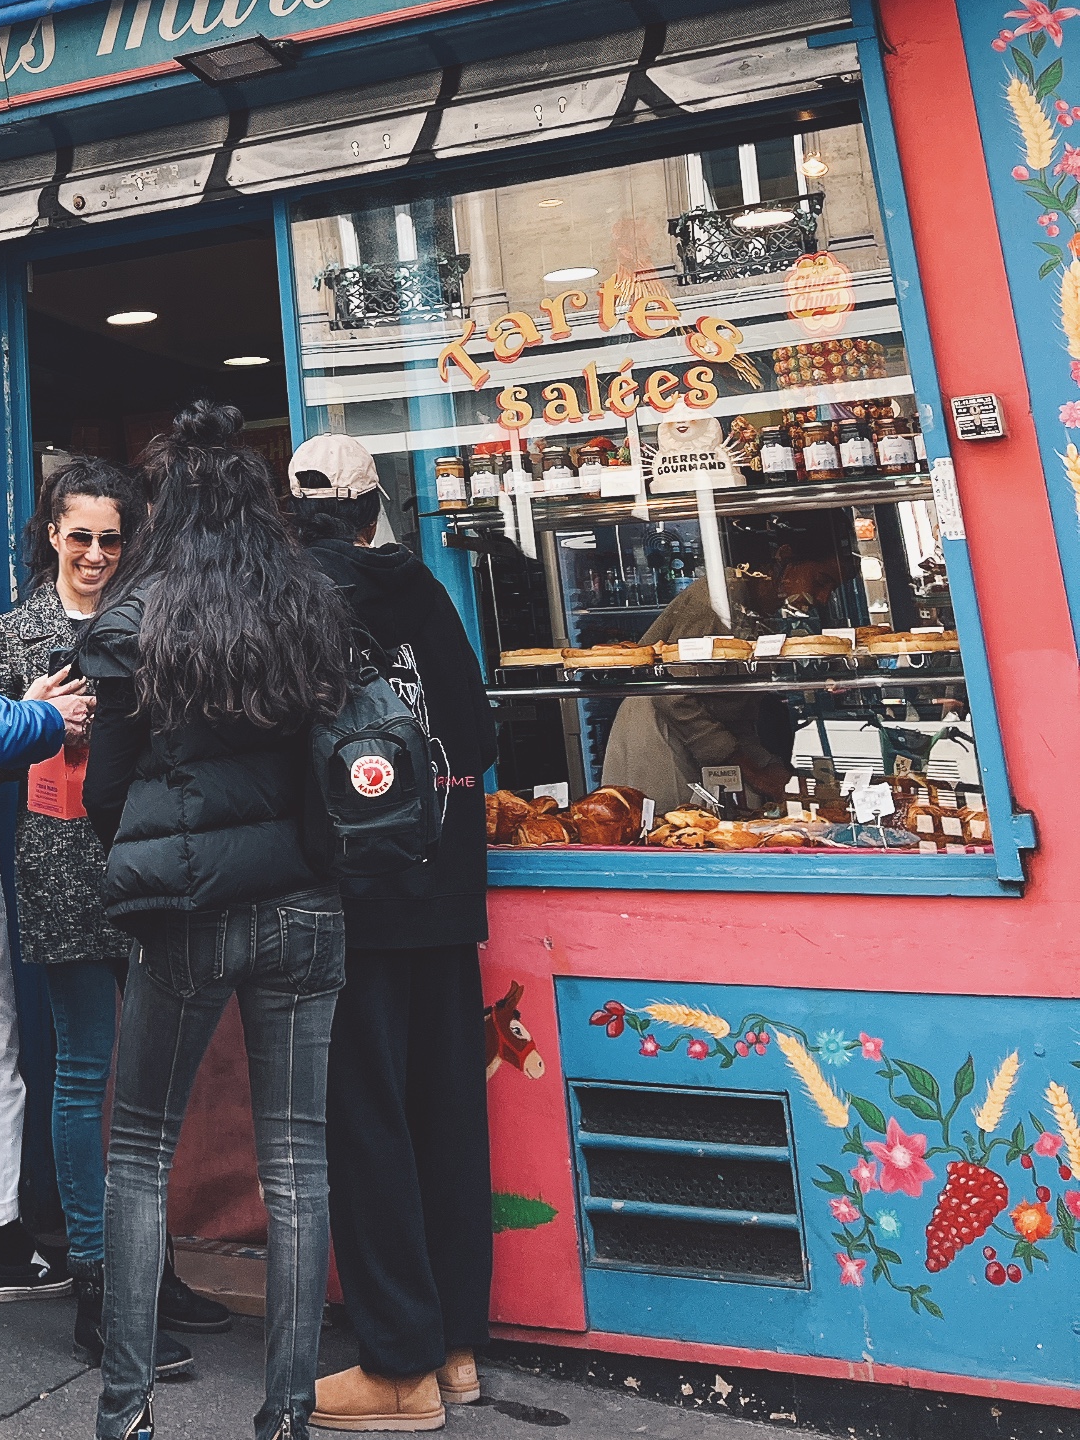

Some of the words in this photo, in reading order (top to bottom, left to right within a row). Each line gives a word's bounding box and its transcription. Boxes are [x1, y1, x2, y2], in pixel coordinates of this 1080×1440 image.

[437, 272, 744, 391] Tartes
[495, 357, 719, 431] salées
[657, 462, 726, 475] GOURMAND
[661, 452, 716, 464] PIERROT
